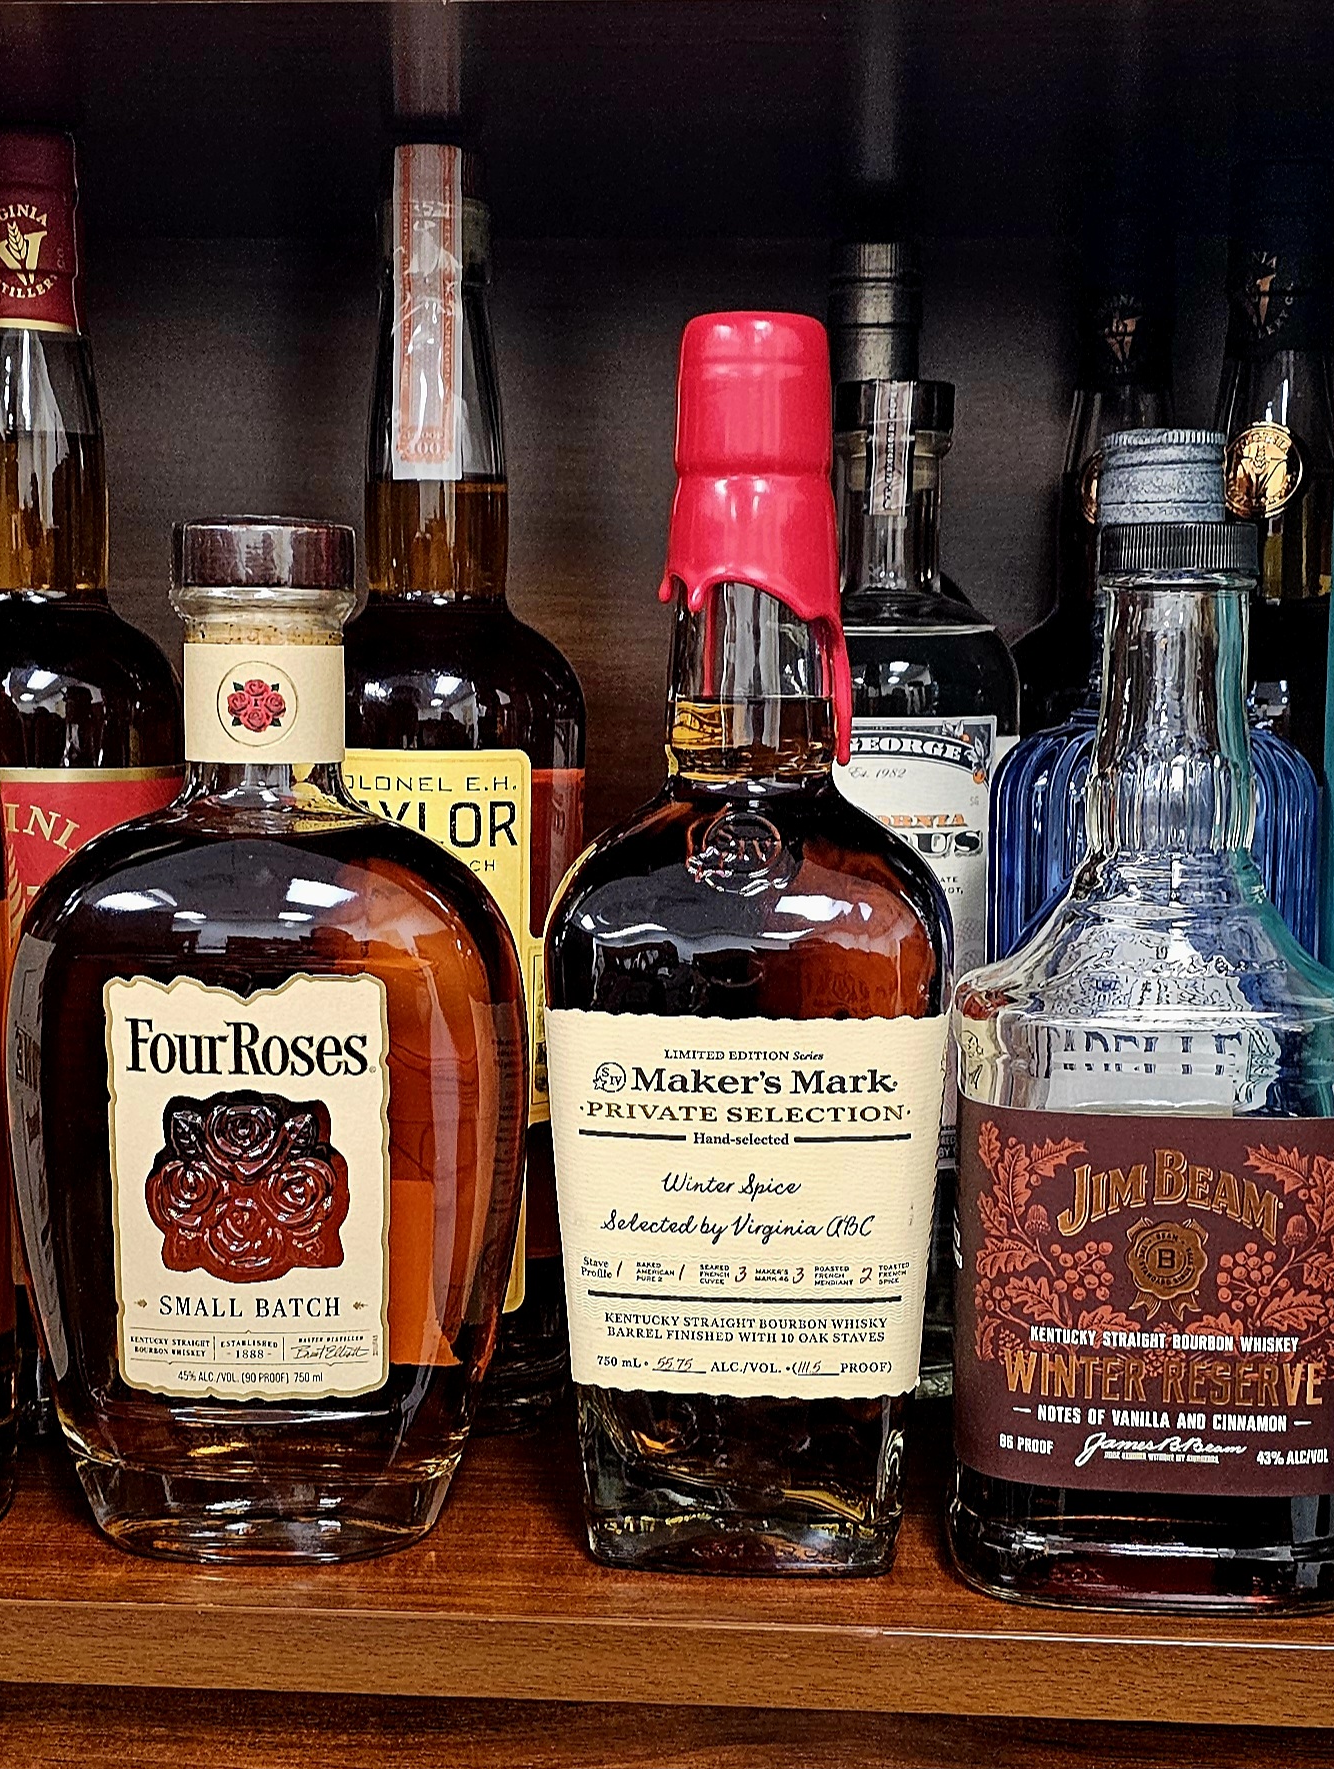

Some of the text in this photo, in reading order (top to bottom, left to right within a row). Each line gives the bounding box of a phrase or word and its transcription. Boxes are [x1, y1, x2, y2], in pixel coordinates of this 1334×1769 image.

[875, 768, 907, 778] 1982
[467, 776, 516, 791] E.H.
[125, 1017, 368, 1076] Four Roses
[664, 1049, 824, 1061] LIMITED EDITION Series
[631, 1067, 781, 1094] Maker's
[693, 1132, 789, 1145] Hand-selected
[661, 1172, 802, 1201] Winter Spice
[1057, 1148, 1278, 1245] JIM BEAM
[600, 1209, 875, 1244] Selected by Virginia ABC
[1158, 1248, 1175, 1268] B
[159, 1295, 341, 1318] SMALL BATCH
[605, 1312, 888, 1329] KENTUCKY STRAIGHT BOURBON WHISKY
[172, 1339, 210, 1347] STRAIGHT
[607, 1326, 885, 1343] BARREL FINISHED WITH 10 OAK STAVES
[1030, 1325, 1299, 1353] KENTUCKY STRAIGHT BOURBON WHISKEY
[135, 1346, 205, 1357] BOURBON WHISKEY
[221, 1339, 278, 1349] ESTABLISHED
[236, 1349, 264, 1360] 1888
[597, 1356, 892, 1374] 750 mL ALC./VOL. PROOF)
[178, 1370, 323, 1384] 45% (90 PROOF) 750 ml
[1004, 1348, 1324, 1406] WINTER RESERVE
[1037, 1404, 1288, 1432] NOTES OF VANILLA AND CINNAMON
[999, 1433, 1054, 1454] 86 PROOF
[1256, 1449, 1328, 1465] 43% ALC/VOL
